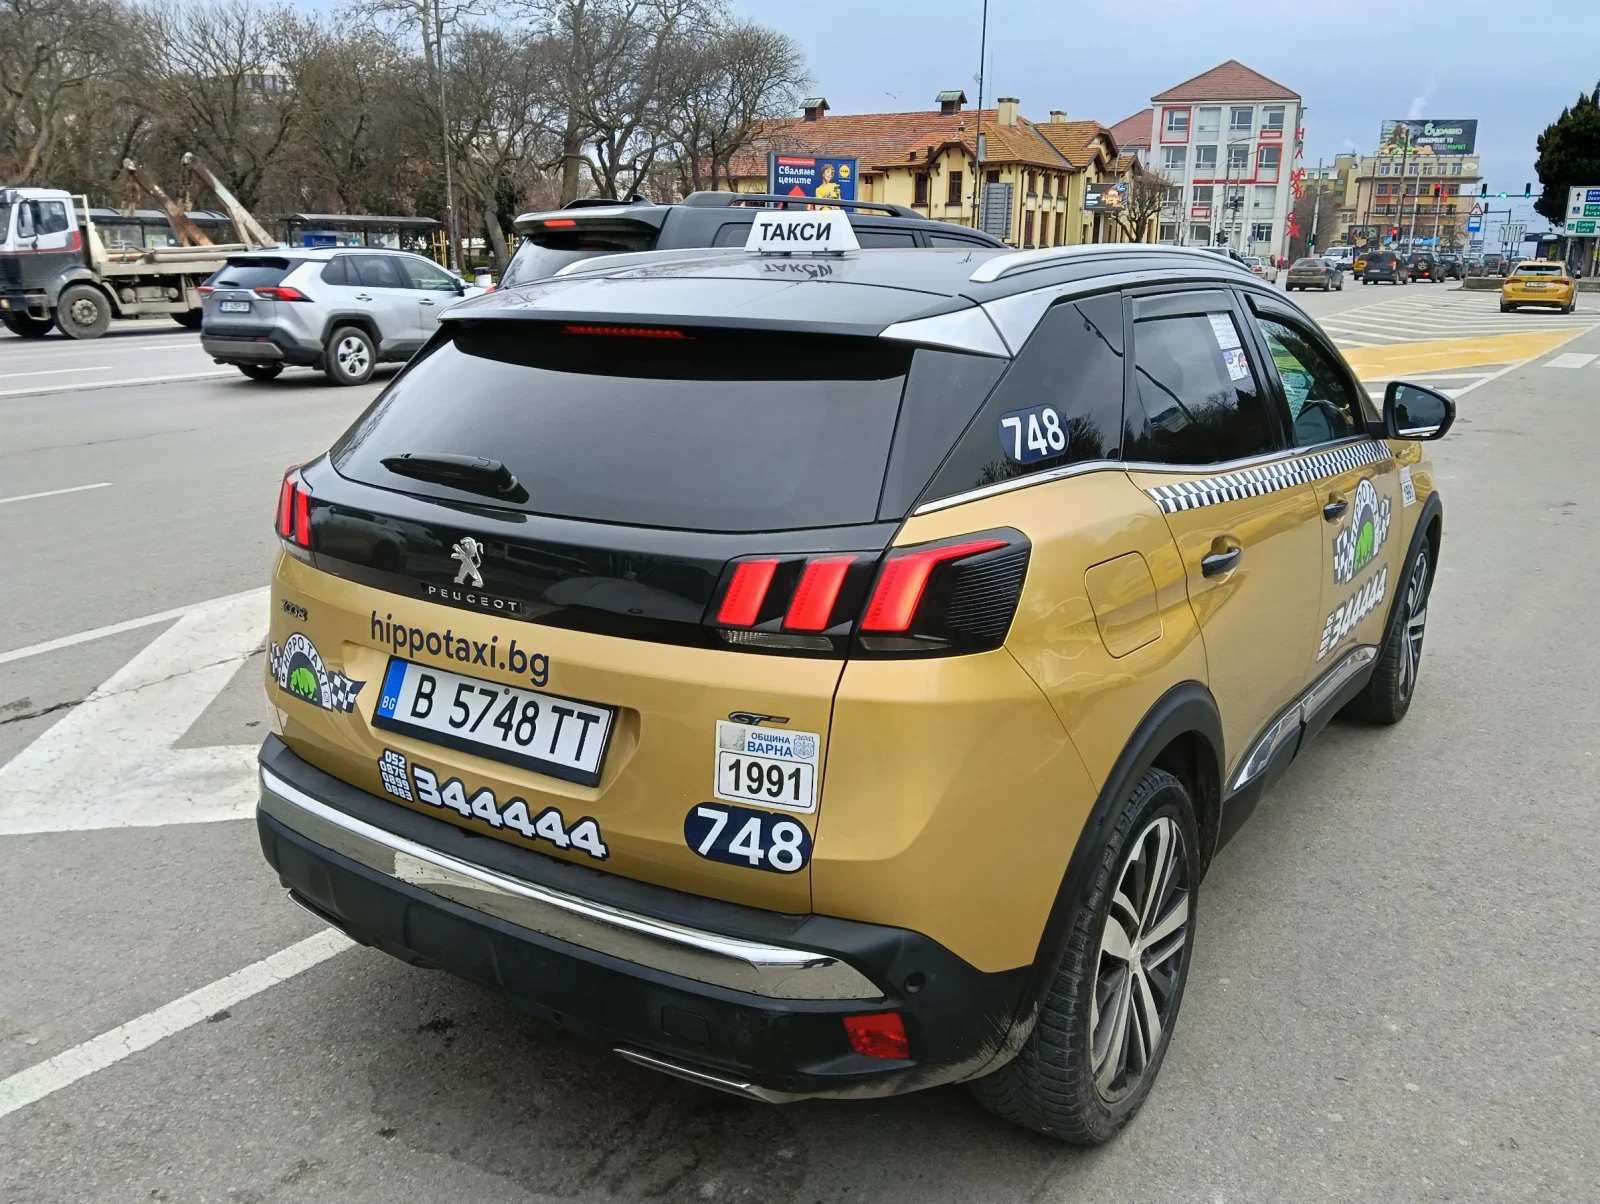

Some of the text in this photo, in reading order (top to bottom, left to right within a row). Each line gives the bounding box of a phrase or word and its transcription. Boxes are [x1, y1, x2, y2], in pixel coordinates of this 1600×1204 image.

[778, 166, 815, 175] Сваляме
[778, 176, 812, 185] цените
[760, 222, 832, 241] ТАКСИ
[1001, 407, 1066, 461] 748
[428, 586, 517, 611] PEUGEOT
[1328, 567, 1387, 650] 344444
[371, 610, 550, 688] hippotaxi.bg
[283, 636, 328, 687] HIPPO TAXI
[381, 695, 396, 710] BG
[410, 673, 601, 762] B 5748 TT
[751, 732, 791, 745] ОБЩИНА
[385, 750, 406, 769] 052
[747, 741, 794, 758] ВАРНА
[379, 760, 407, 780] 0876
[729, 758, 801, 801] 1991
[381, 771, 410, 791] 0899
[384, 782, 413, 802] 0883
[413, 766, 607, 858] 344444
[697, 806, 803, 872] 748
